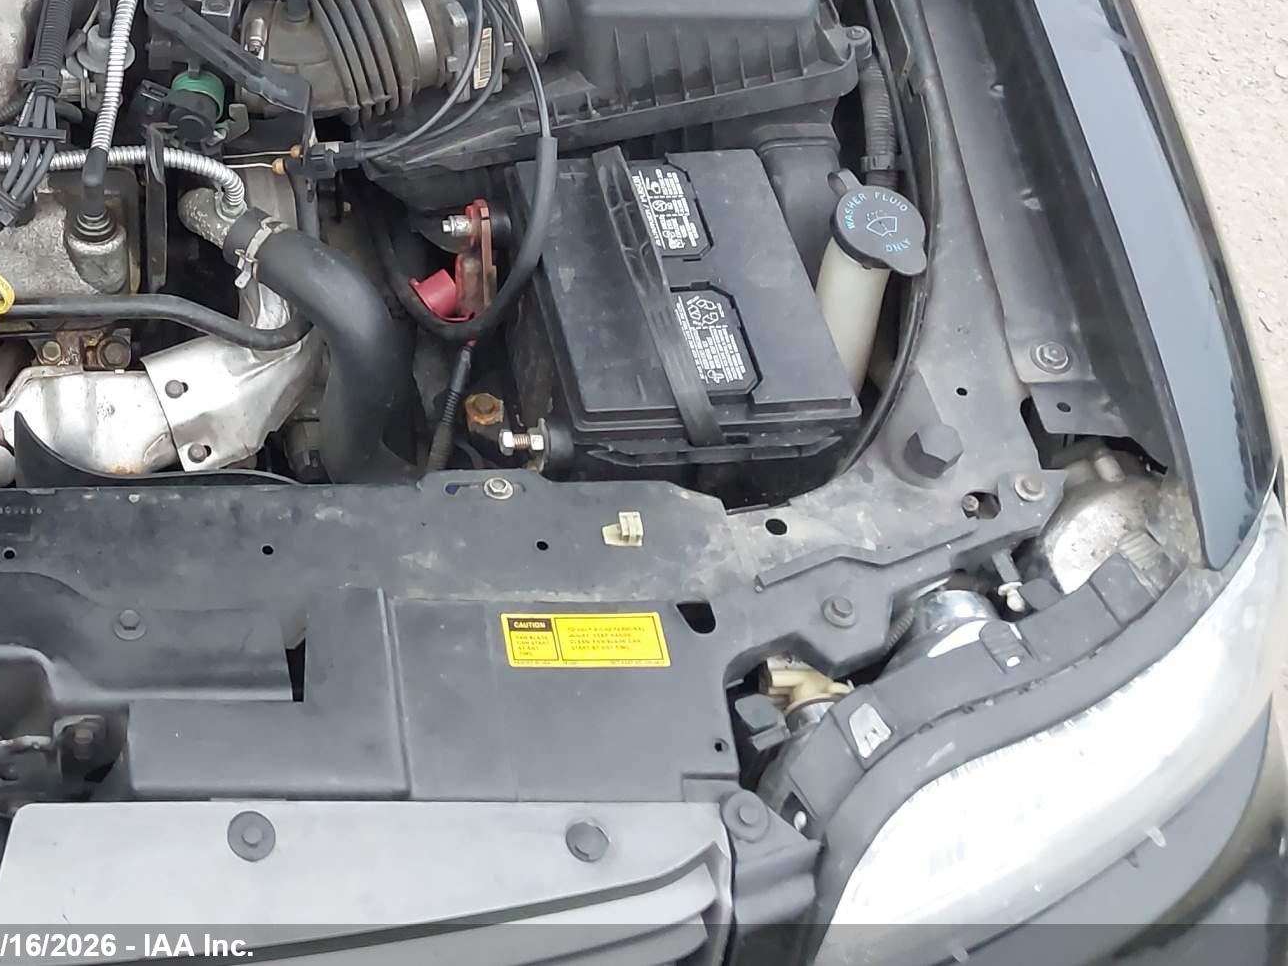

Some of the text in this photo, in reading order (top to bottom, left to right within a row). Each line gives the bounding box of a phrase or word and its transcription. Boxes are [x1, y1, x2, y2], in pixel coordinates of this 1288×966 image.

[844, 191, 909, 230] WASHER FLUID
[886, 238, 911, 253] ONLY
[513, 621, 546, 630] CAUTION
